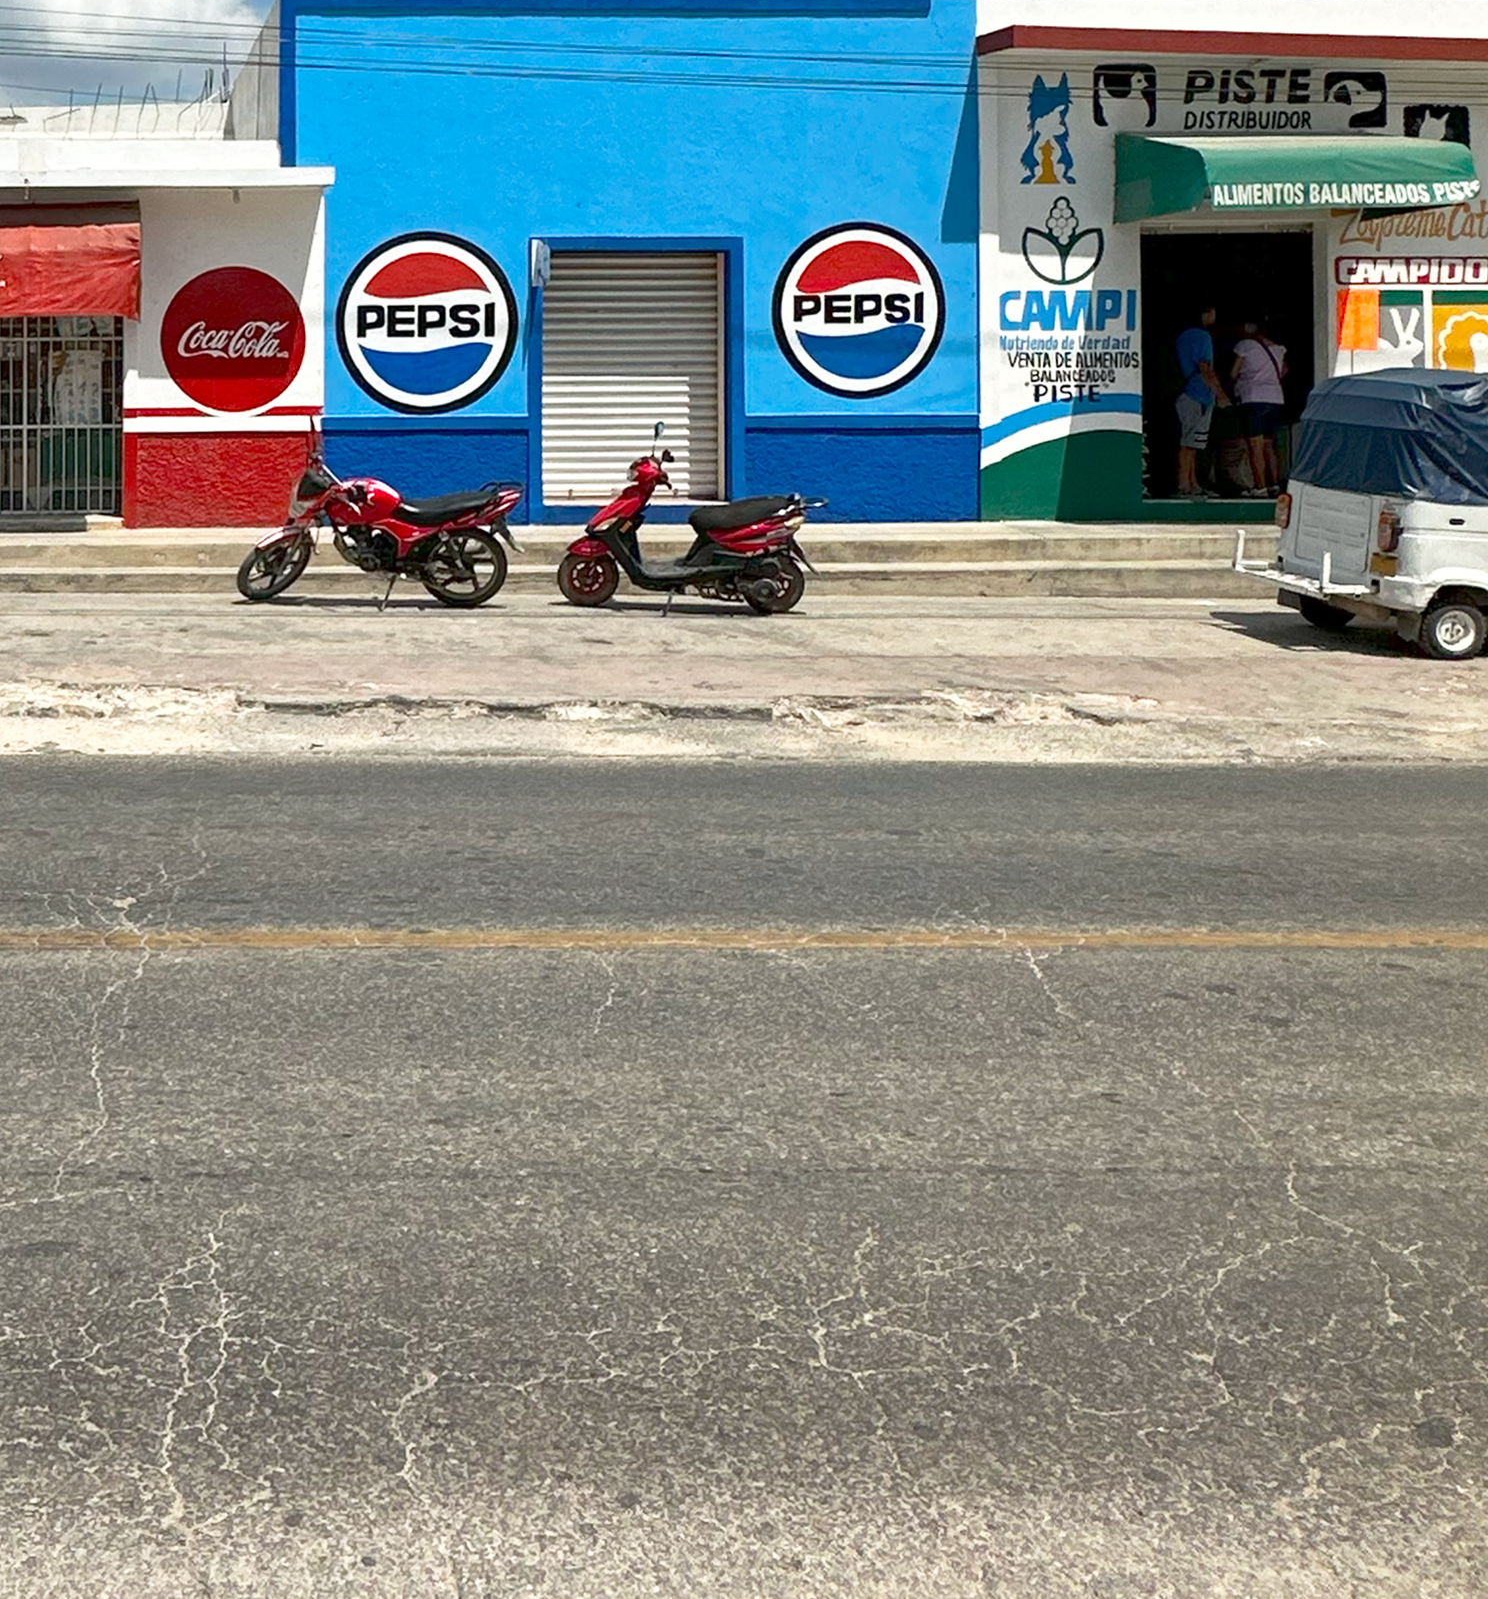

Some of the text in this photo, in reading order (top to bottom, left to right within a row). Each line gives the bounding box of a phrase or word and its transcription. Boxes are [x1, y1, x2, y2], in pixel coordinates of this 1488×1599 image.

[1183, 69, 1311, 104] PISTE
[1183, 111, 1311, 130] DISTRIBUIDOR
[1213, 182, 1305, 206] ALIMENTOS
[1309, 182, 1430, 205] BALANCEADOS
[356, 302, 496, 339] PEPSI
[793, 291, 925, 325] PEPSI
[999, 289, 1138, 332] CAMPI
[177, 321, 290, 359] Coca-Cola
[999, 335, 1131, 351] Nutriendo de Verdad
[1007, 352, 1140, 368] VENTA DE ALIMENTOS
[1030, 369, 1116, 383] BALANCEADOS
